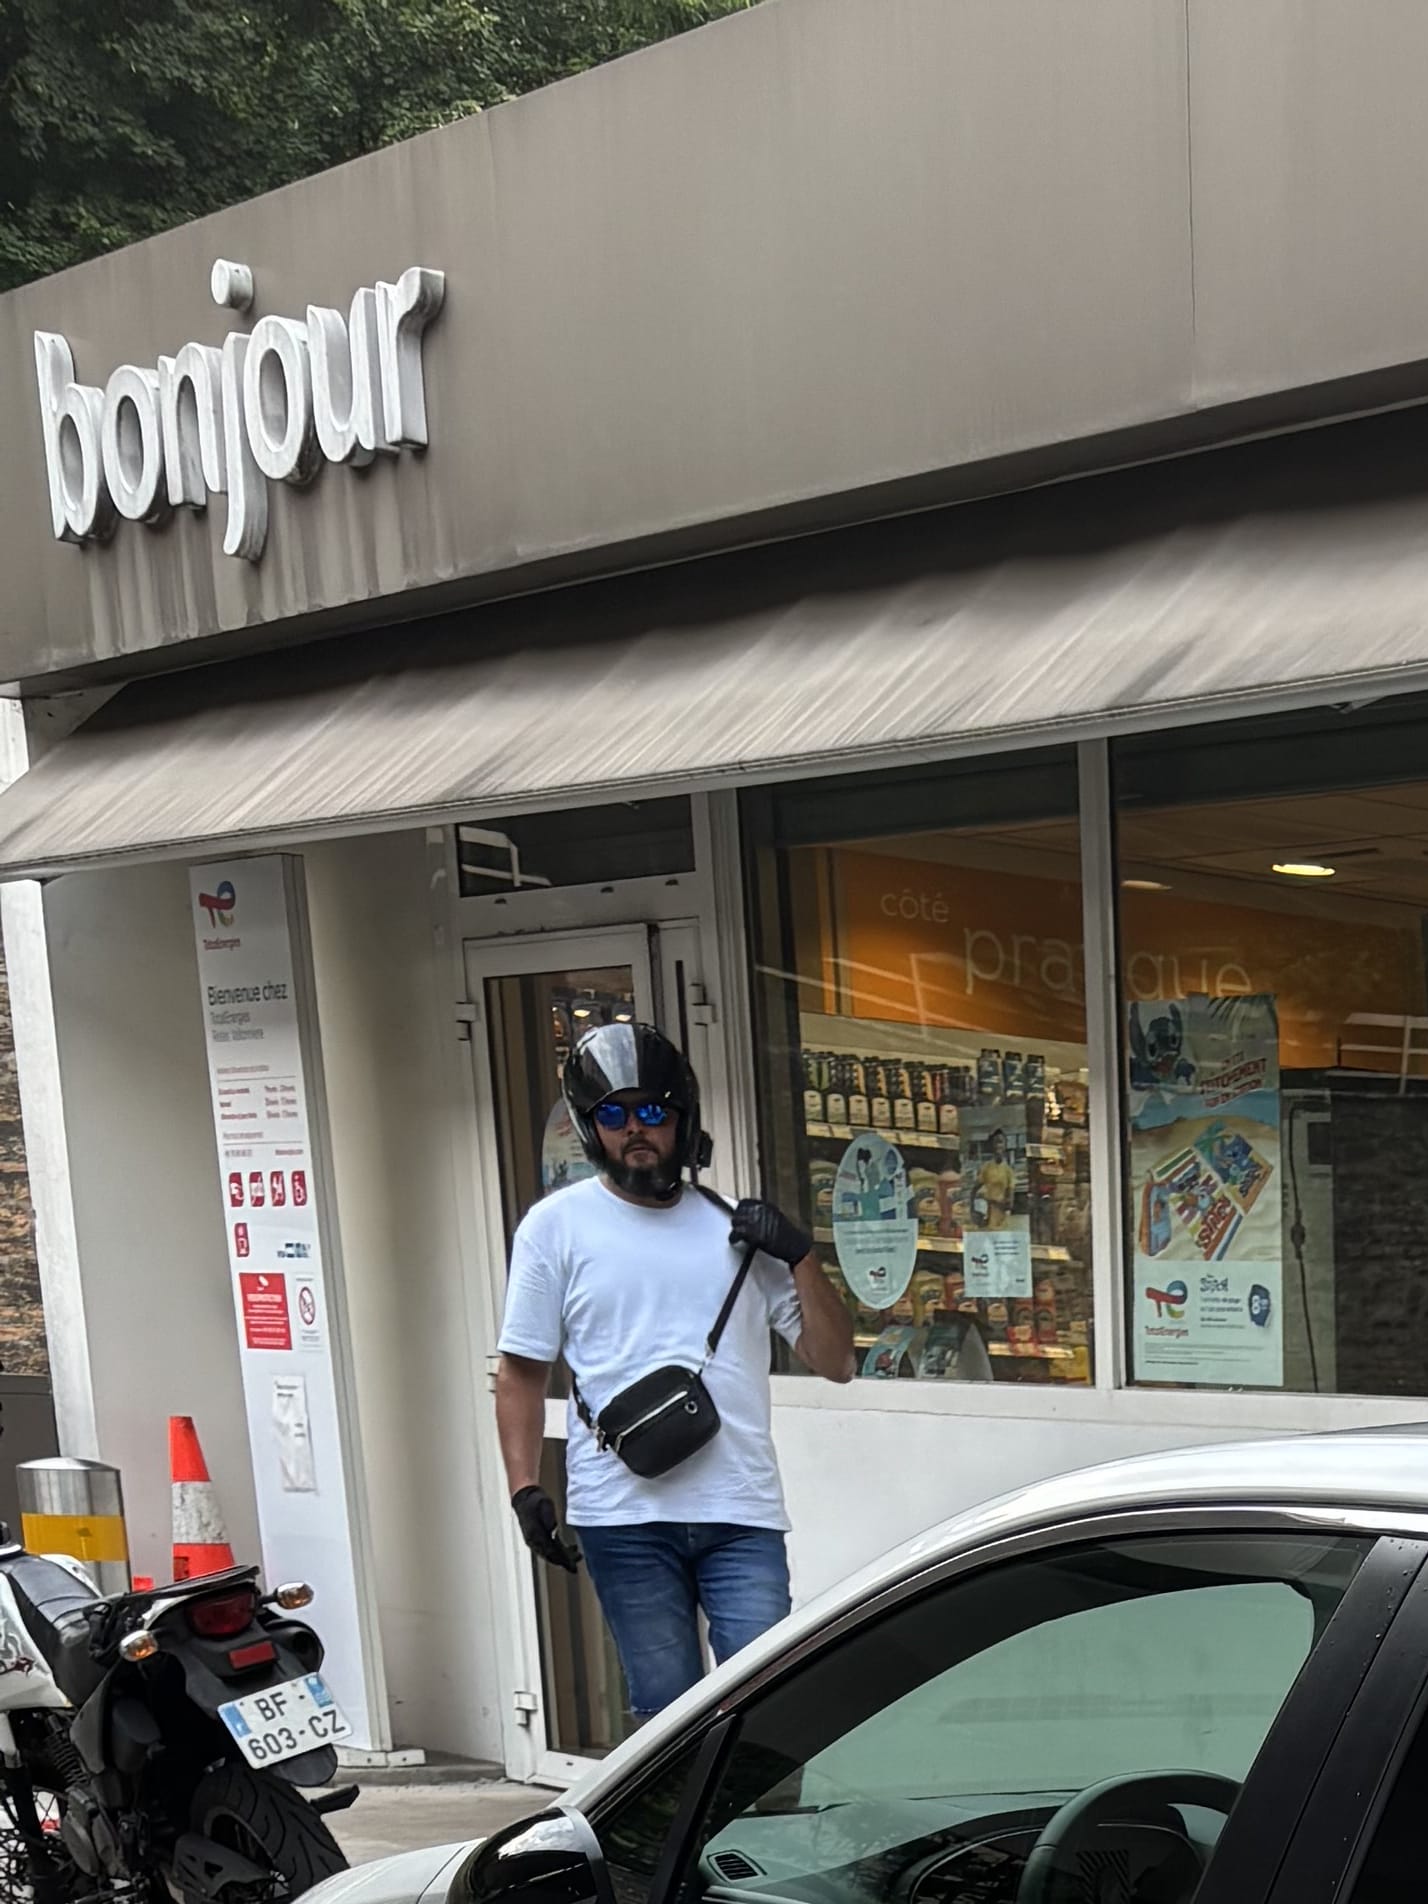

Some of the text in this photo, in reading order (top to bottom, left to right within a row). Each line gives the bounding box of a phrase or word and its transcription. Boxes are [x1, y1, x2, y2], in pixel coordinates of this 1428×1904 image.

[35, 259, 445, 561] bonjour
[881, 889, 950, 923] côté
[207, 979, 289, 1006] Bienvenue chez
[254, 1692, 287, 1721] BF
[248, 1709, 346, 1760] 603-CZ
